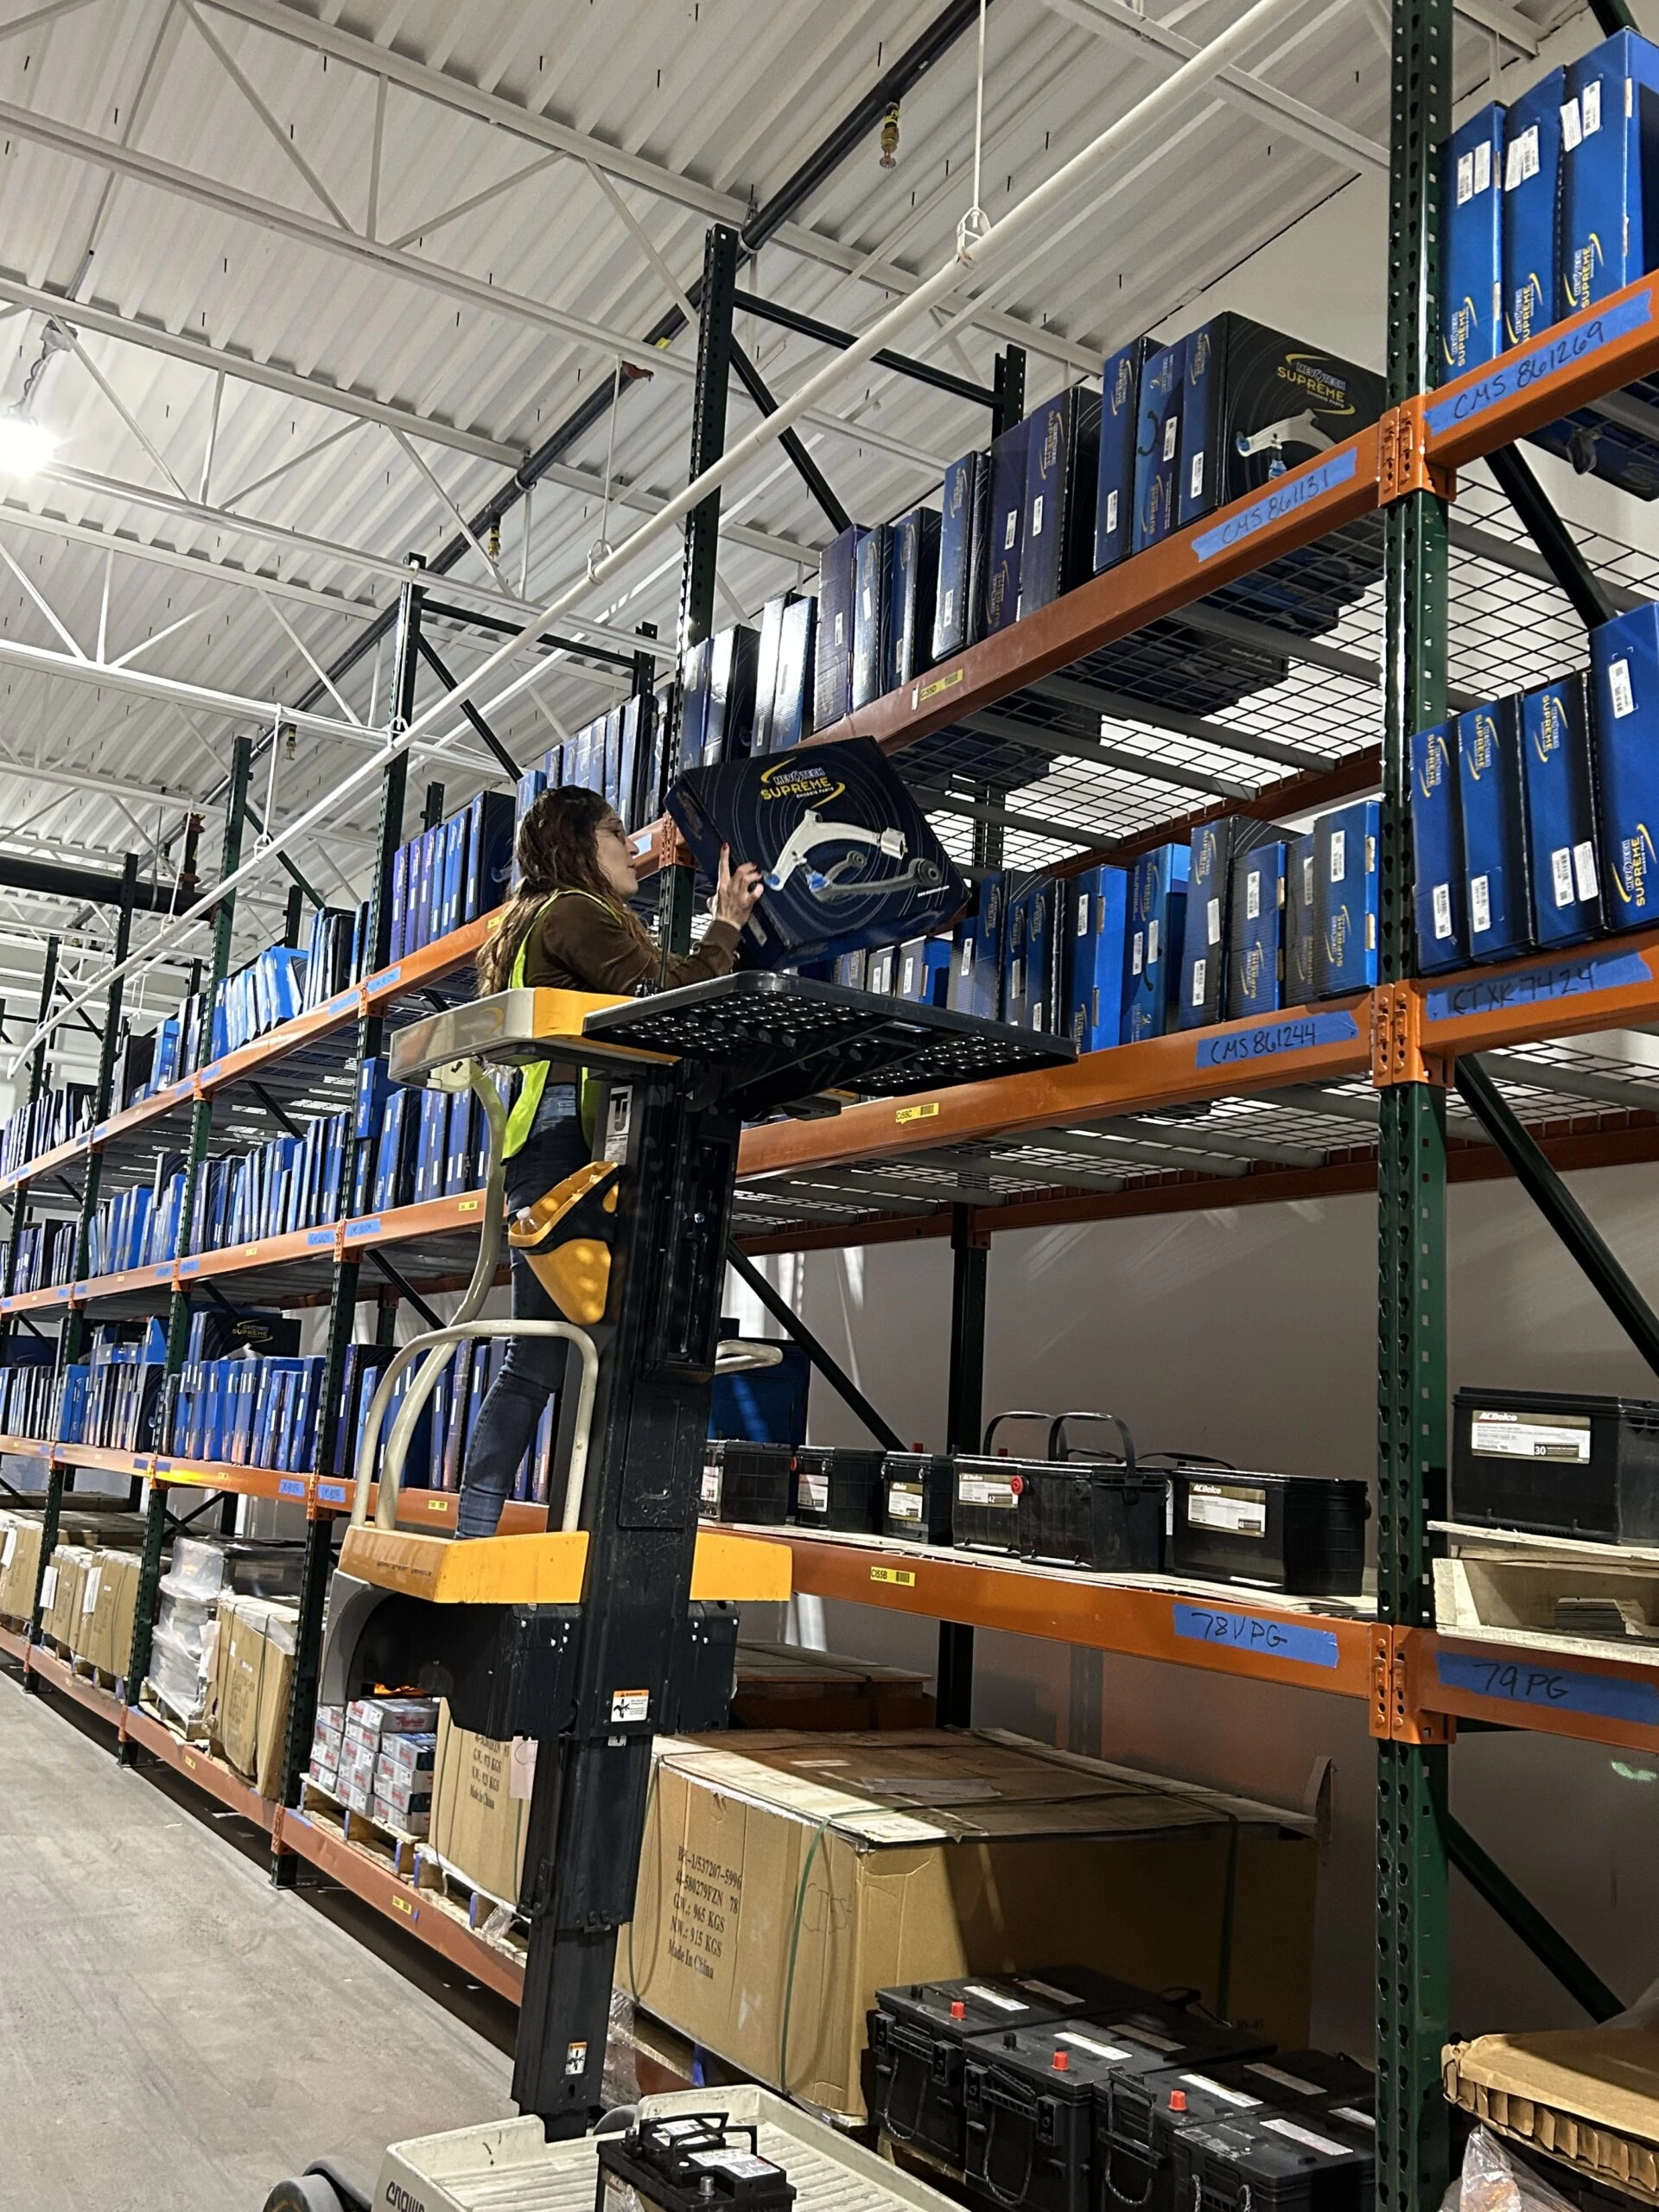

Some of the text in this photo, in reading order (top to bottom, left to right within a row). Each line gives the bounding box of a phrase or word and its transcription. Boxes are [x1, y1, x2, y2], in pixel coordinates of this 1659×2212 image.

[1458, 309, 1467, 366] SUPREME
[1277, 366, 1345, 403] SUPREME
[1453, 321, 1604, 419] CMS 861269
[1223, 469, 1328, 544] CMS 861131
[1475, 715, 1485, 768] SUPREME
[1541, 694, 1552, 750] SUPREME
[760, 777, 831, 800] SUPREME
[1630, 836, 1645, 907] SUPREME
[1211, 1023, 1316, 1064] CMS 861244
[1479, 1412, 1518, 1421] ACDelco
[1535, 1446, 1547, 1456] 30
[1193, 1484, 1222, 1494] ACDelco
[693, 1904, 706, 1923] 965
[708, 1910, 726, 1934] KGS
[730, 1896, 739, 1915] 78
[668, 1939, 714, 1980] Made In China
[690, 1927, 702, 1947] 915
[705, 1935, 722, 1958] KGS
